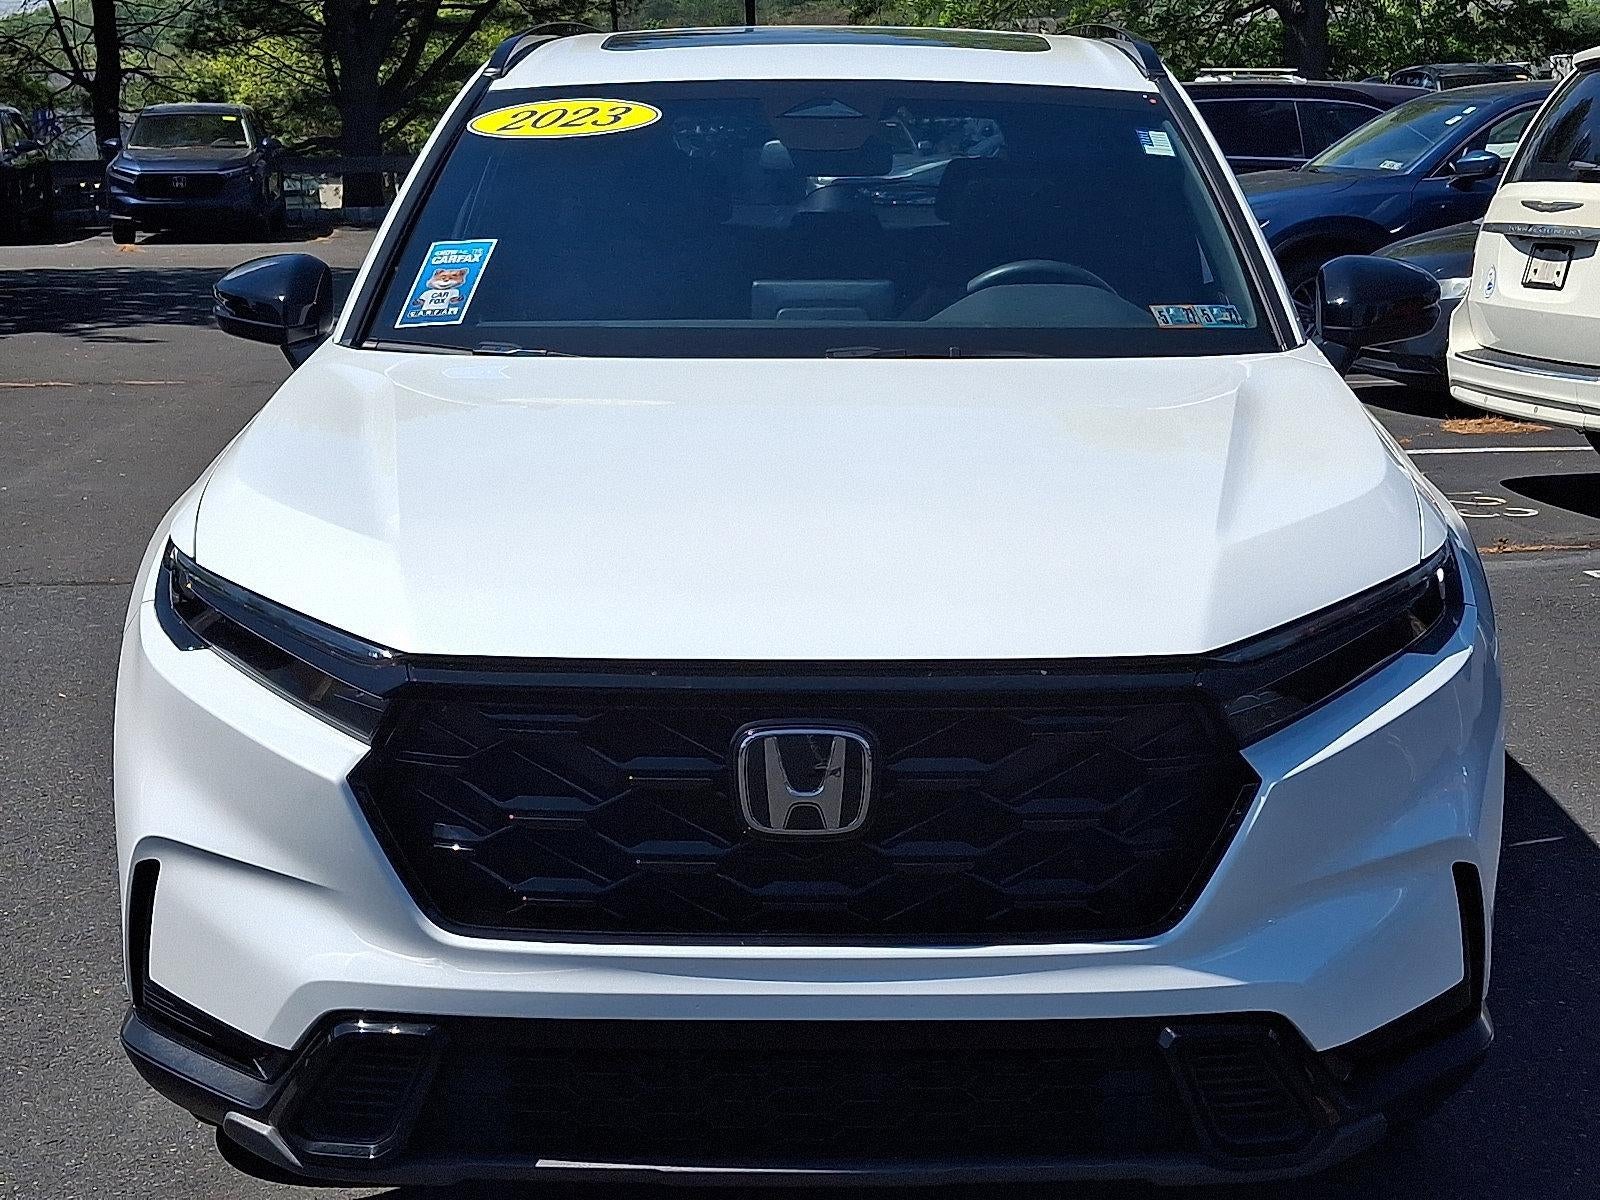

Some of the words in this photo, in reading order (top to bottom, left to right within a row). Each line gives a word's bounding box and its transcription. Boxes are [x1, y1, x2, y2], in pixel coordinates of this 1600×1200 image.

[496, 106, 633, 132] 2023
[431, 252, 483, 265] CARFAX
[431, 291, 450, 299] CAR
[1157, 310, 1170, 325] 5
